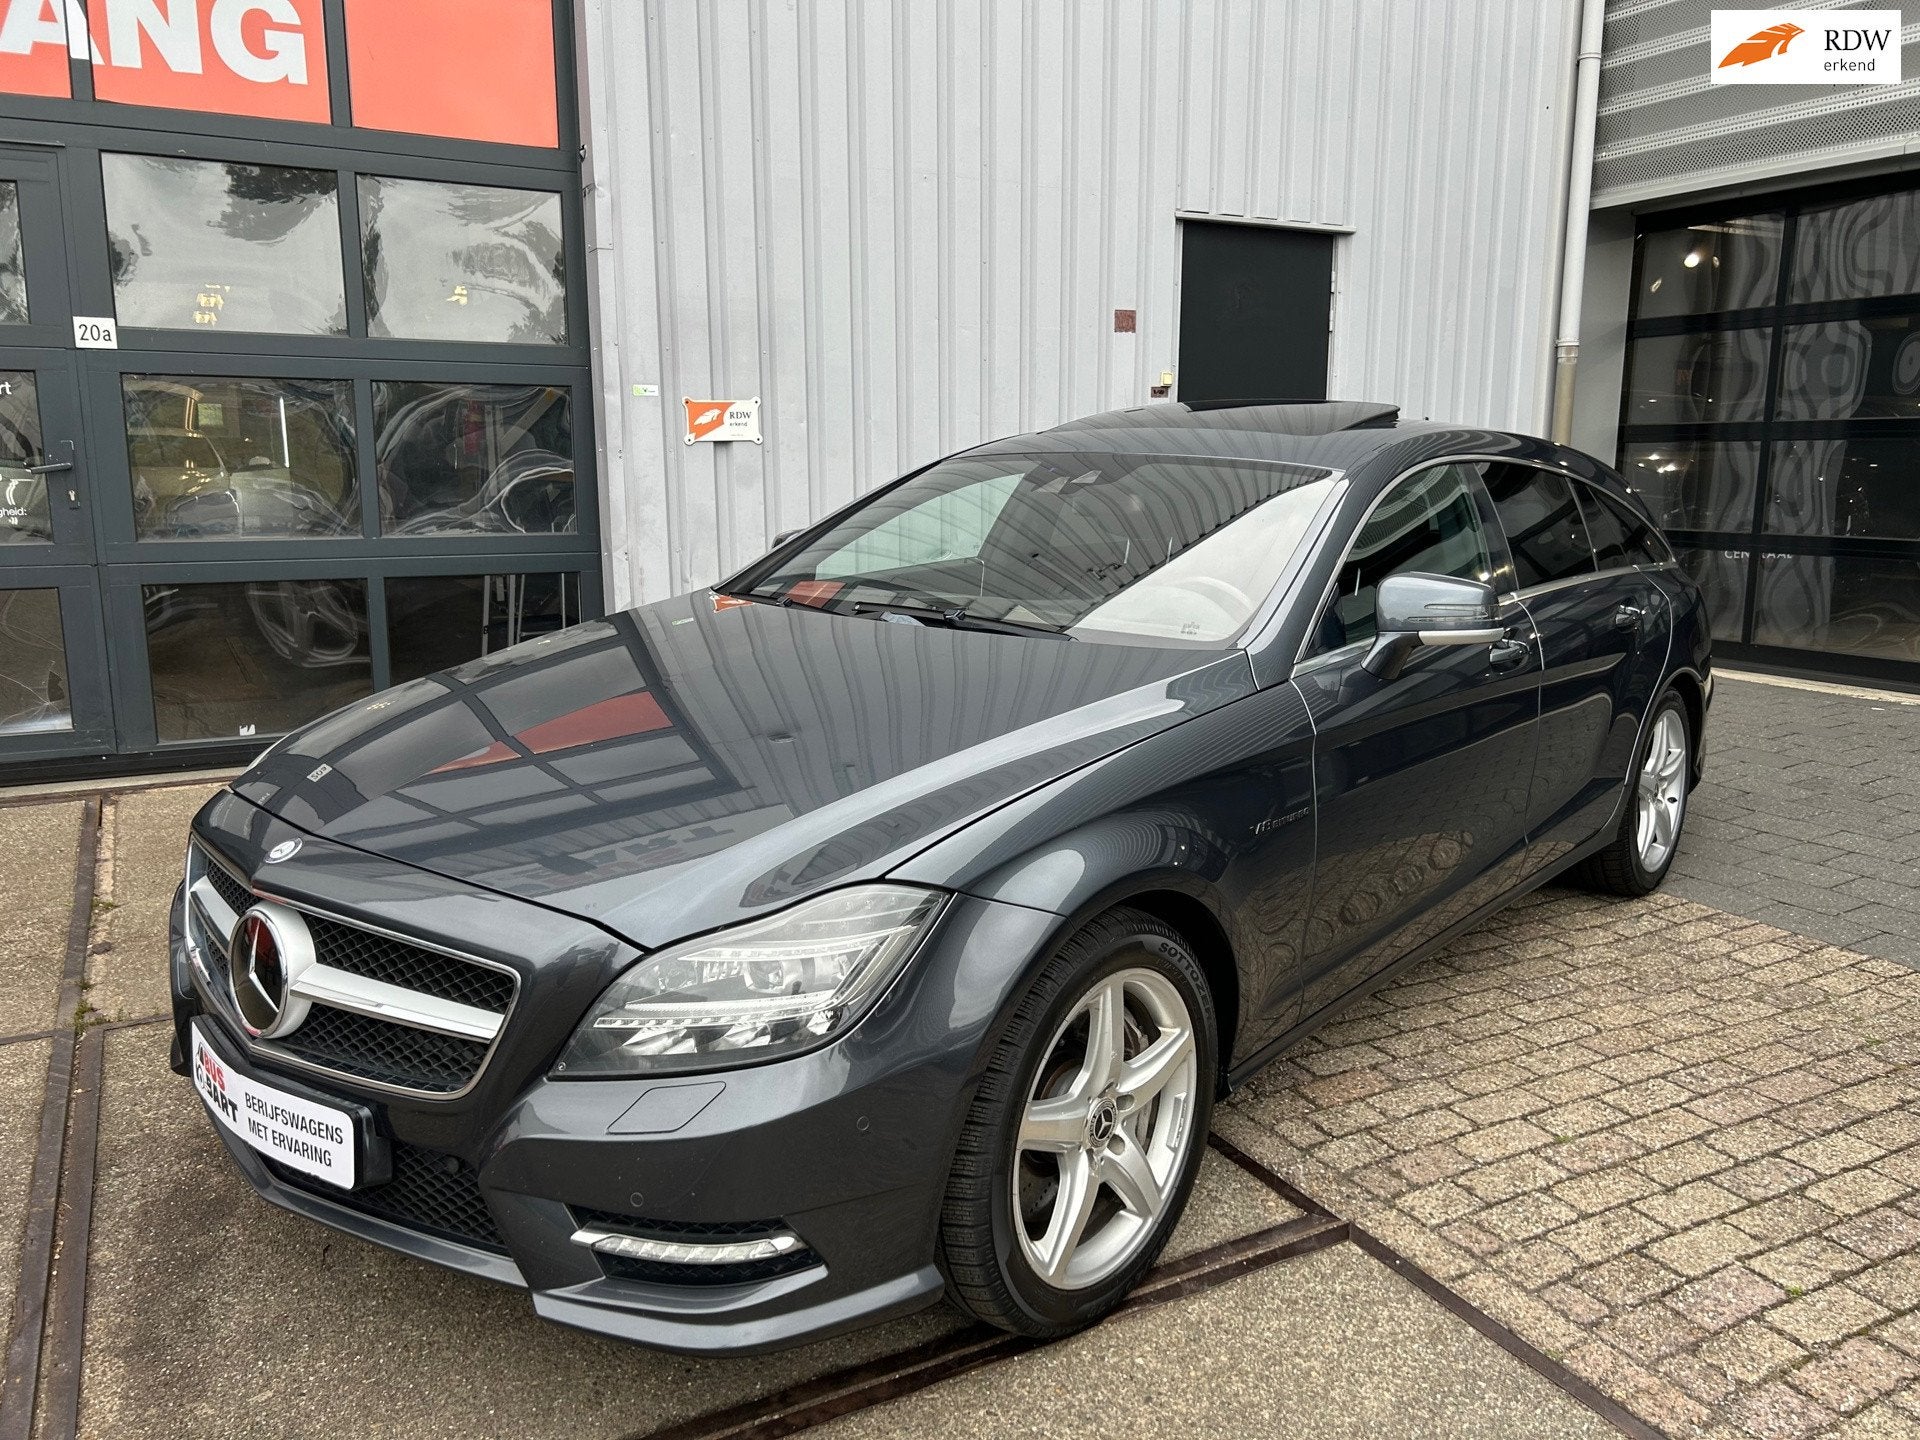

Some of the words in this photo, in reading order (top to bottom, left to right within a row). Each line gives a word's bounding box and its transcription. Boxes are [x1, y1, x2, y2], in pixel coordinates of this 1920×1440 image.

[0, 0, 309, 86] ANG
[78, 323, 113, 342] 20a
[729, 411, 752, 420] RDW
[244, 1091, 344, 1145] BERIJFSWAGENS
[248, 1116, 268, 1141] MET
[272, 1129, 332, 1168] ERVARING
